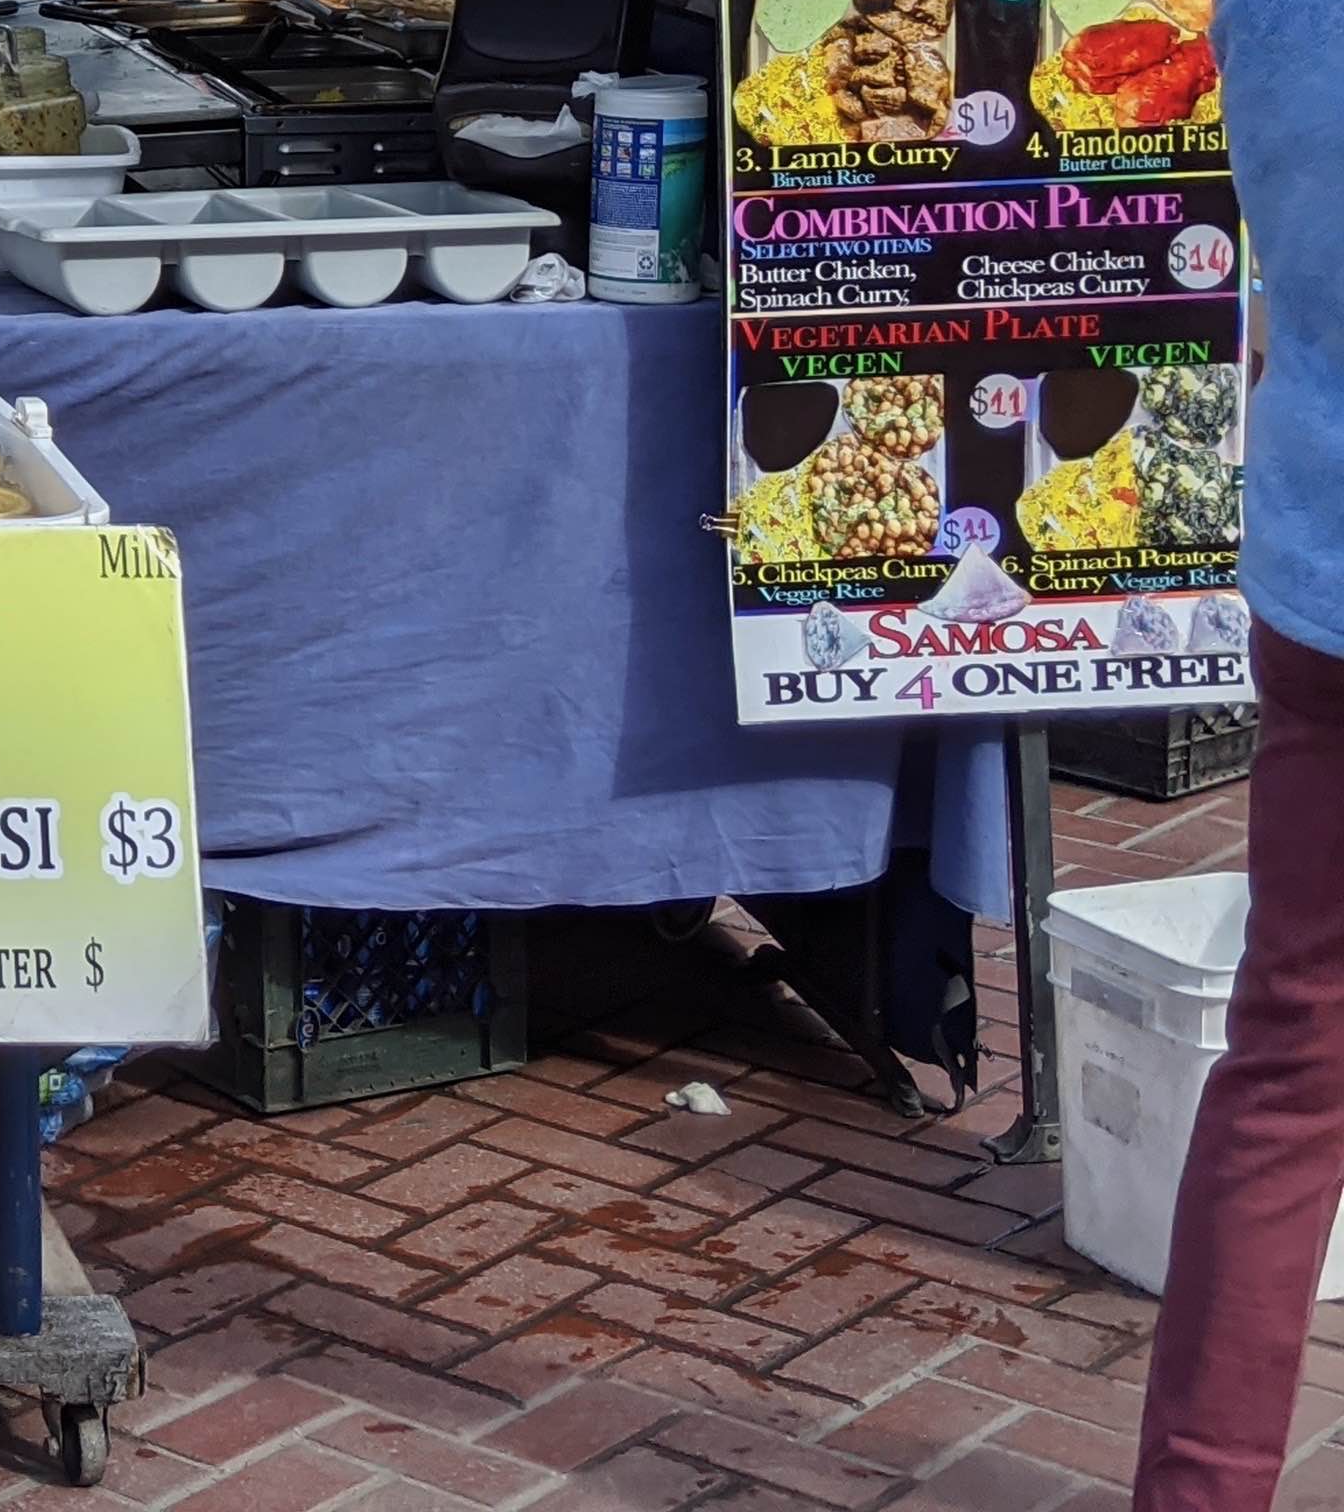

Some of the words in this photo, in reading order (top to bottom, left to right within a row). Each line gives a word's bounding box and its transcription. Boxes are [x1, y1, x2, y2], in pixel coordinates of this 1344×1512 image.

[872, 238, 933, 255] ITEMS
[780, 351, 903, 377] VEGEN
[1087, 341, 1210, 368] VEGEN
[99, 533, 177, 579] Milk
[106, 801, 177, 875] $3
[84, 936, 105, 991] $
